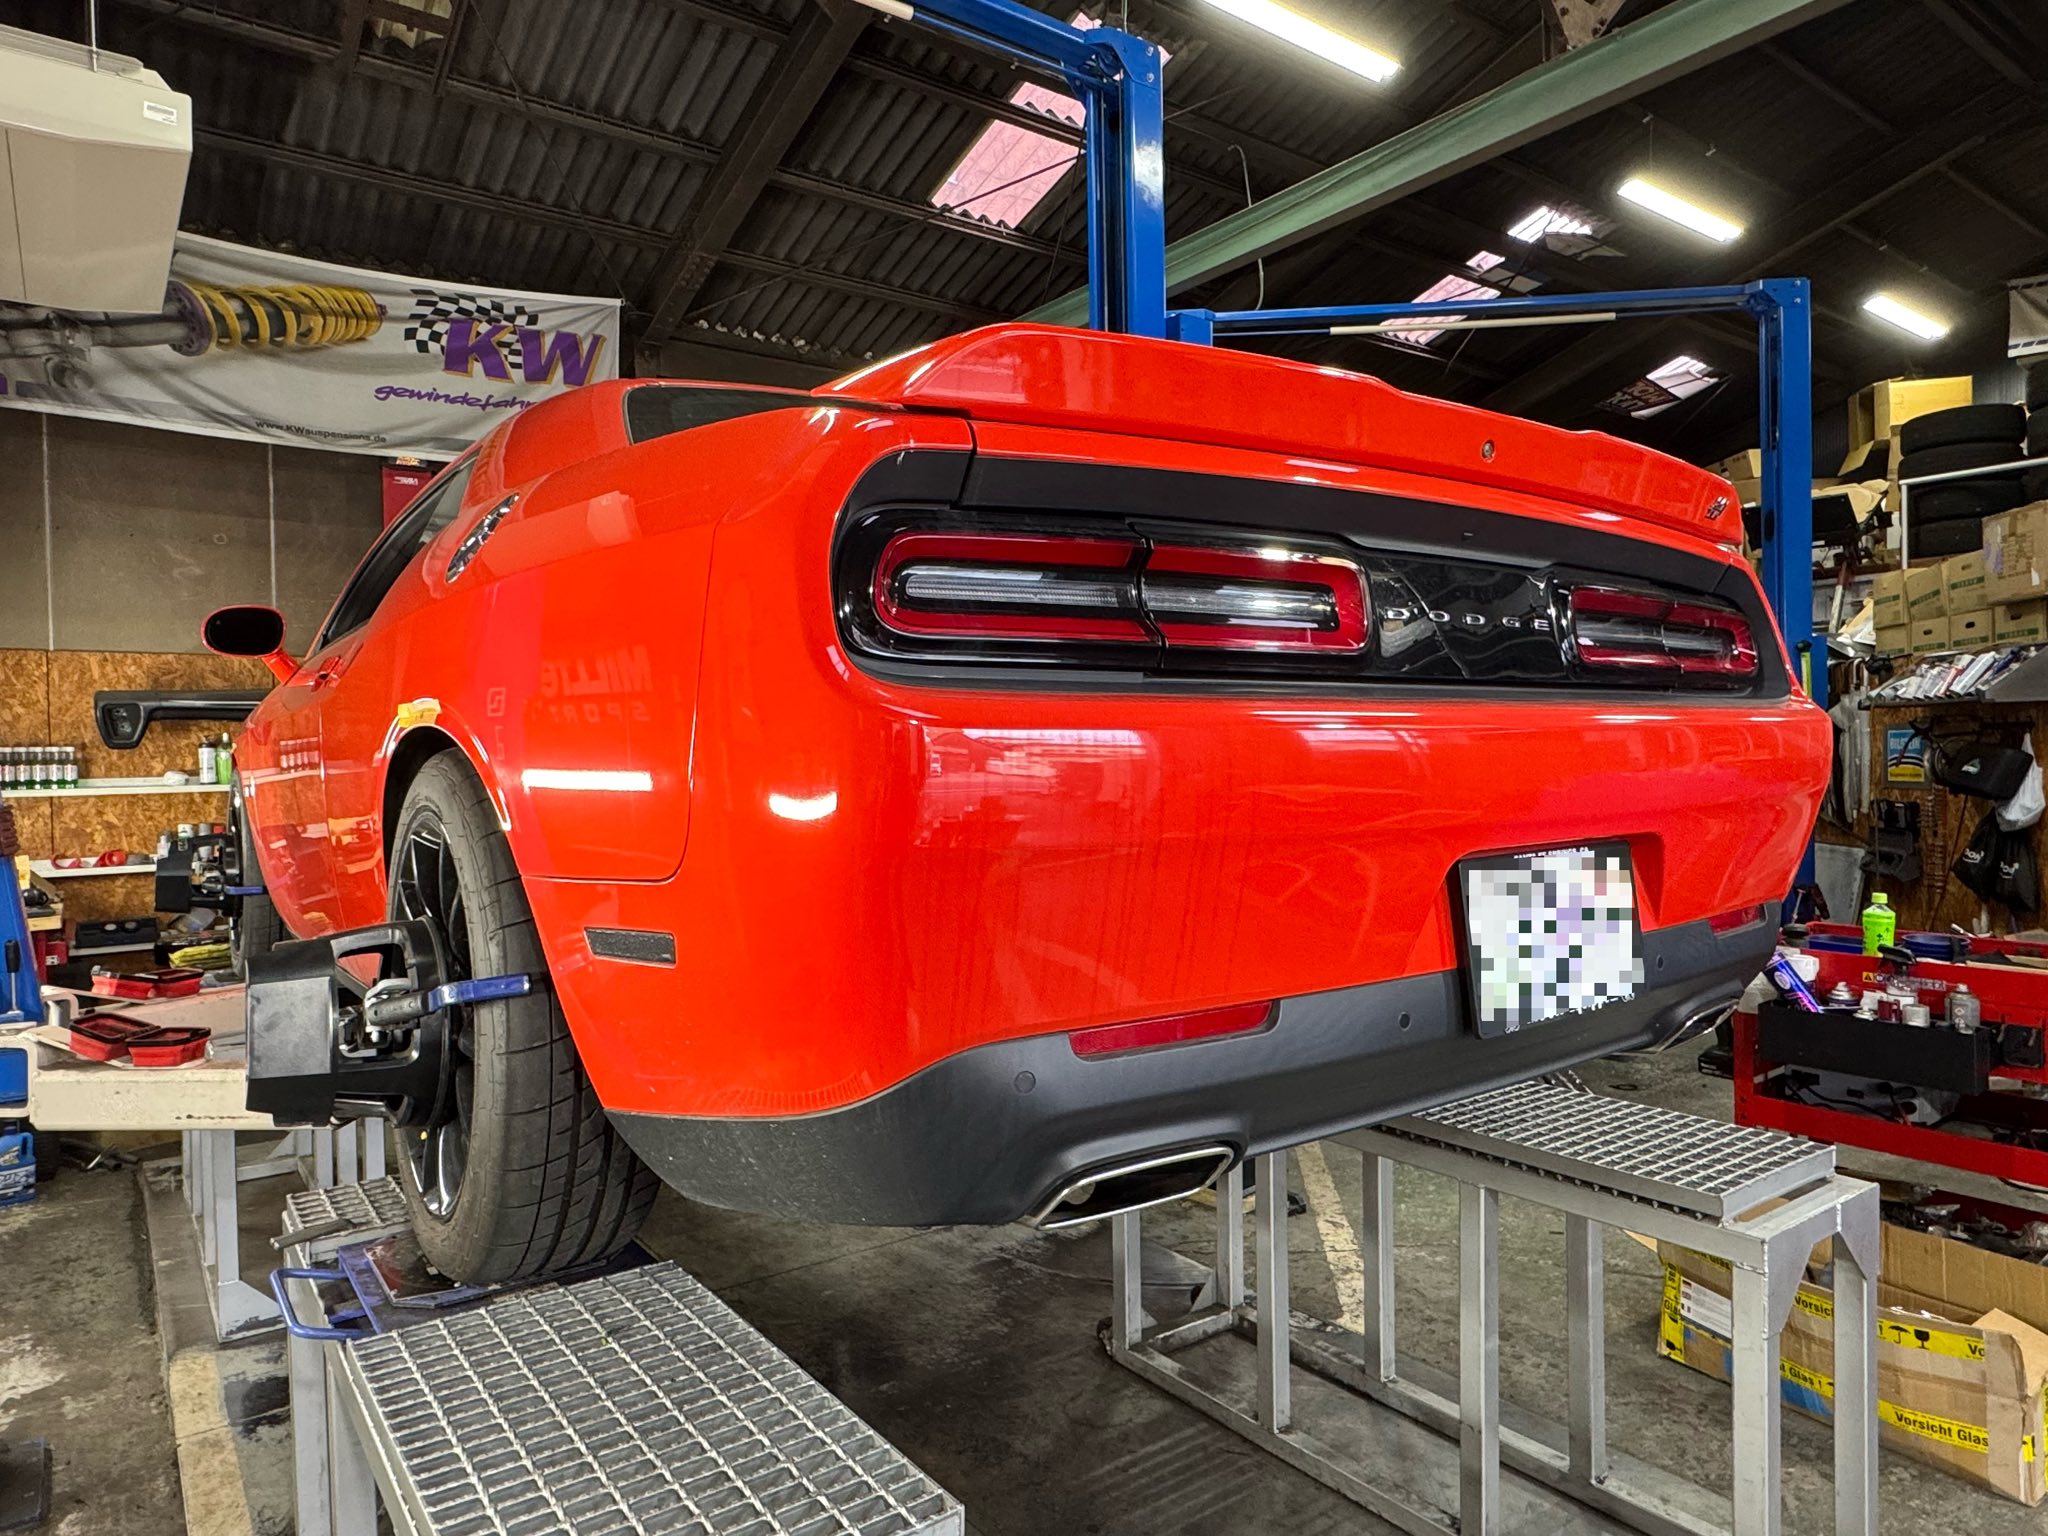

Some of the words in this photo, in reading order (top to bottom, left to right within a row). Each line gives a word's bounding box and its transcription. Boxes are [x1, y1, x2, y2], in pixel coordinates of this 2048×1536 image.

[442, 318, 607, 388] KW
[254, 420, 387, 443] www.KWsuspensions.de
[1384, 606, 1551, 632] DODGE
[1794, 1295, 1834, 1318] Vorsic
[1788, 1366, 1815, 1386] Glas
[1894, 1410, 1953, 1438] Vorsicht
[1956, 1428, 1989, 1447] Glas
